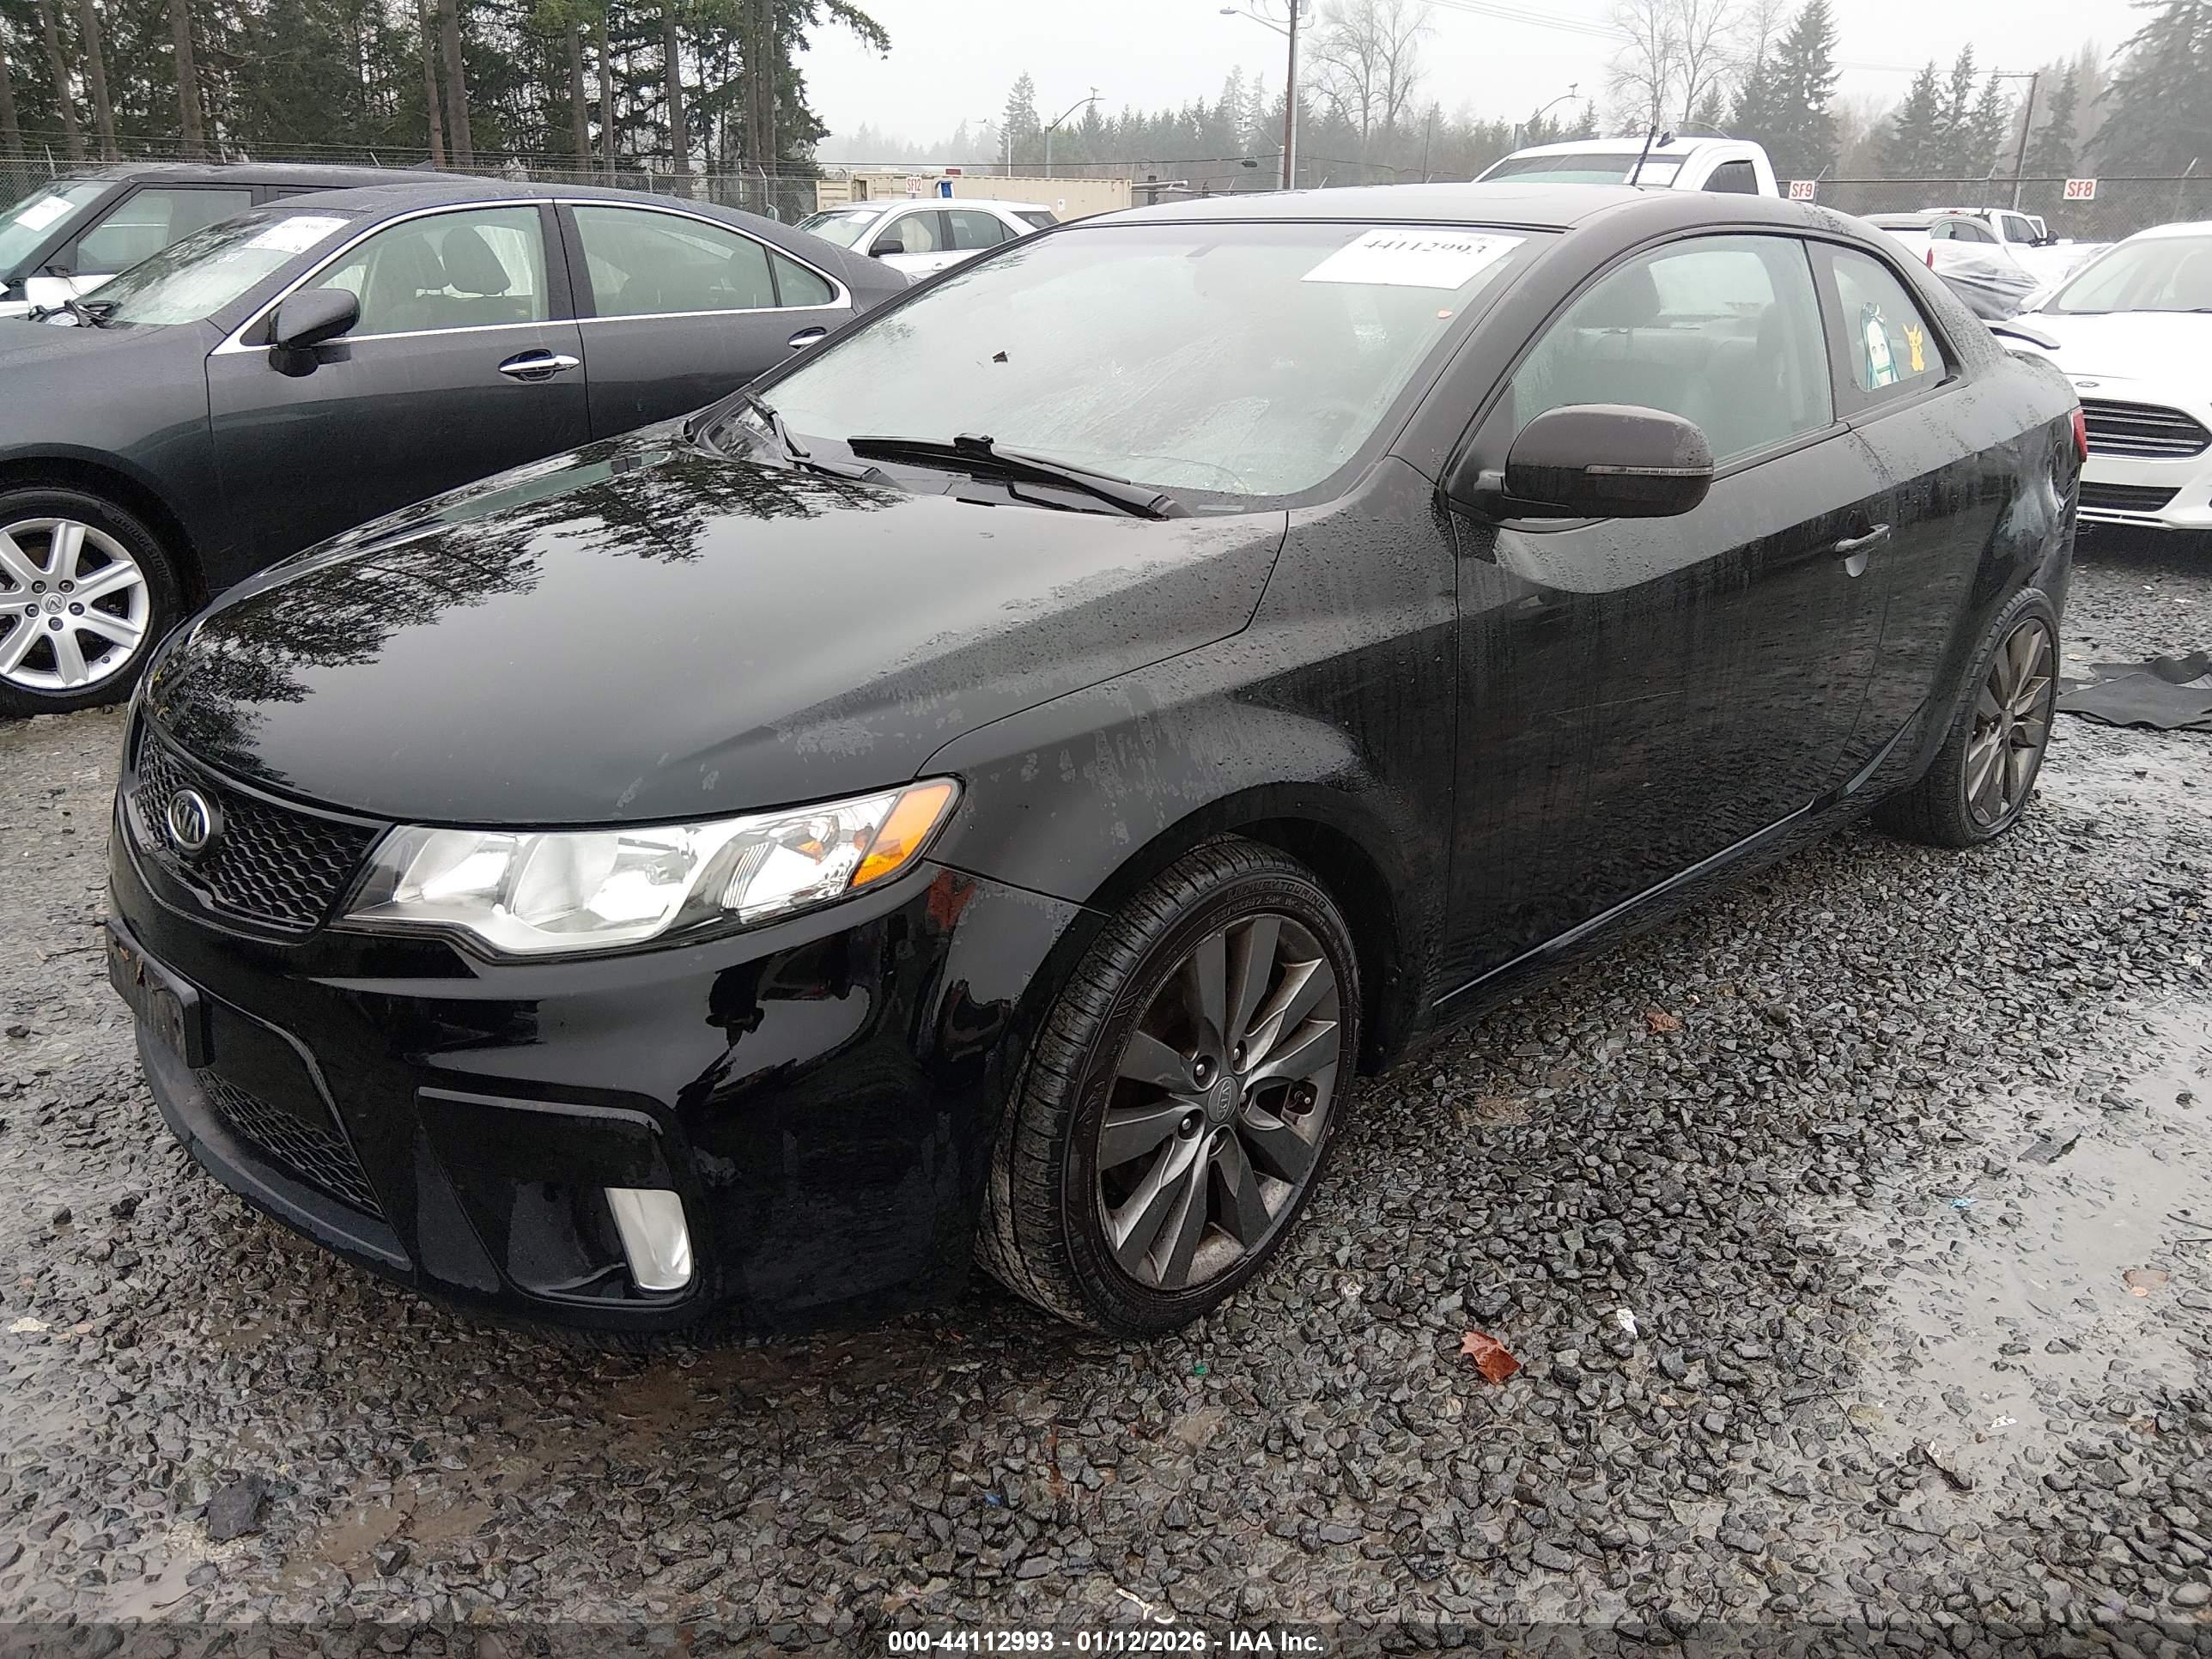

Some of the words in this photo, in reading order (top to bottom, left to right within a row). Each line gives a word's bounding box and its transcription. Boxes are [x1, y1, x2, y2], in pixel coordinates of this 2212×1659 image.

[907, 179, 921, 191] SF12
[1791, 183, 1813, 198] SF9
[2067, 181, 2093, 197] SF8
